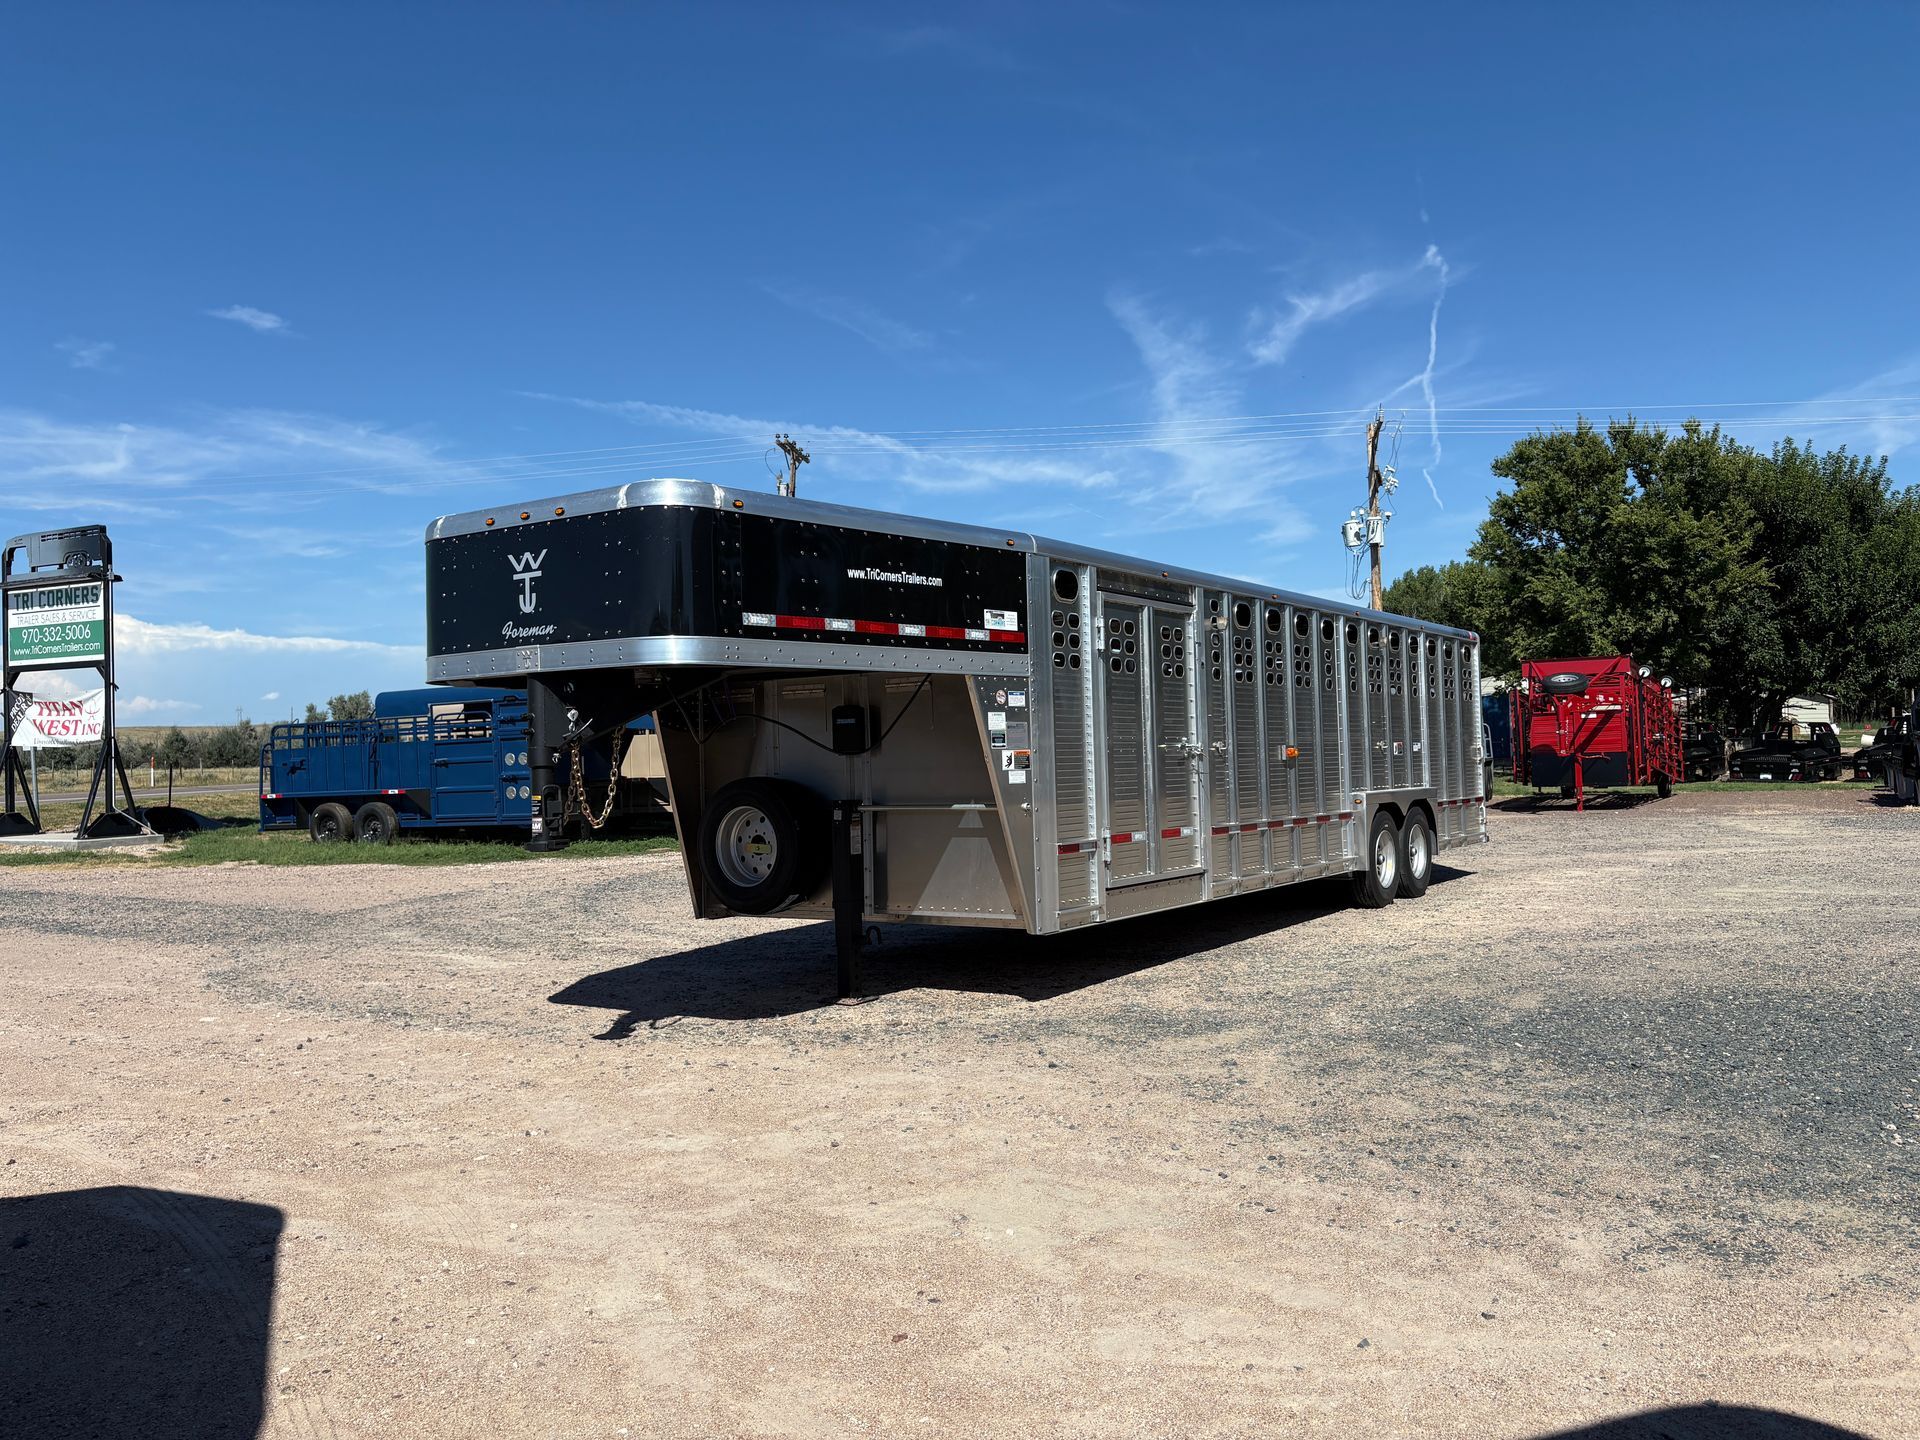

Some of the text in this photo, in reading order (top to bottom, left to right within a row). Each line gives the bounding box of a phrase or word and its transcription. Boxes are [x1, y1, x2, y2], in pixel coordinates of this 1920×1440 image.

[847, 568, 943, 587] www.TriCornersTrailers.com
[14, 585, 99, 611] TRI CORNERS
[17, 609, 97, 626] TRAILER SALES & SERVICE
[22, 624, 91, 643] 970-332-5006
[502, 621, 557, 639] Foreman
[14, 642, 101, 655] www.TriCornersTrailers.com
[33, 700, 84, 717] TITAN
[32, 719, 101, 736] WEST INC
